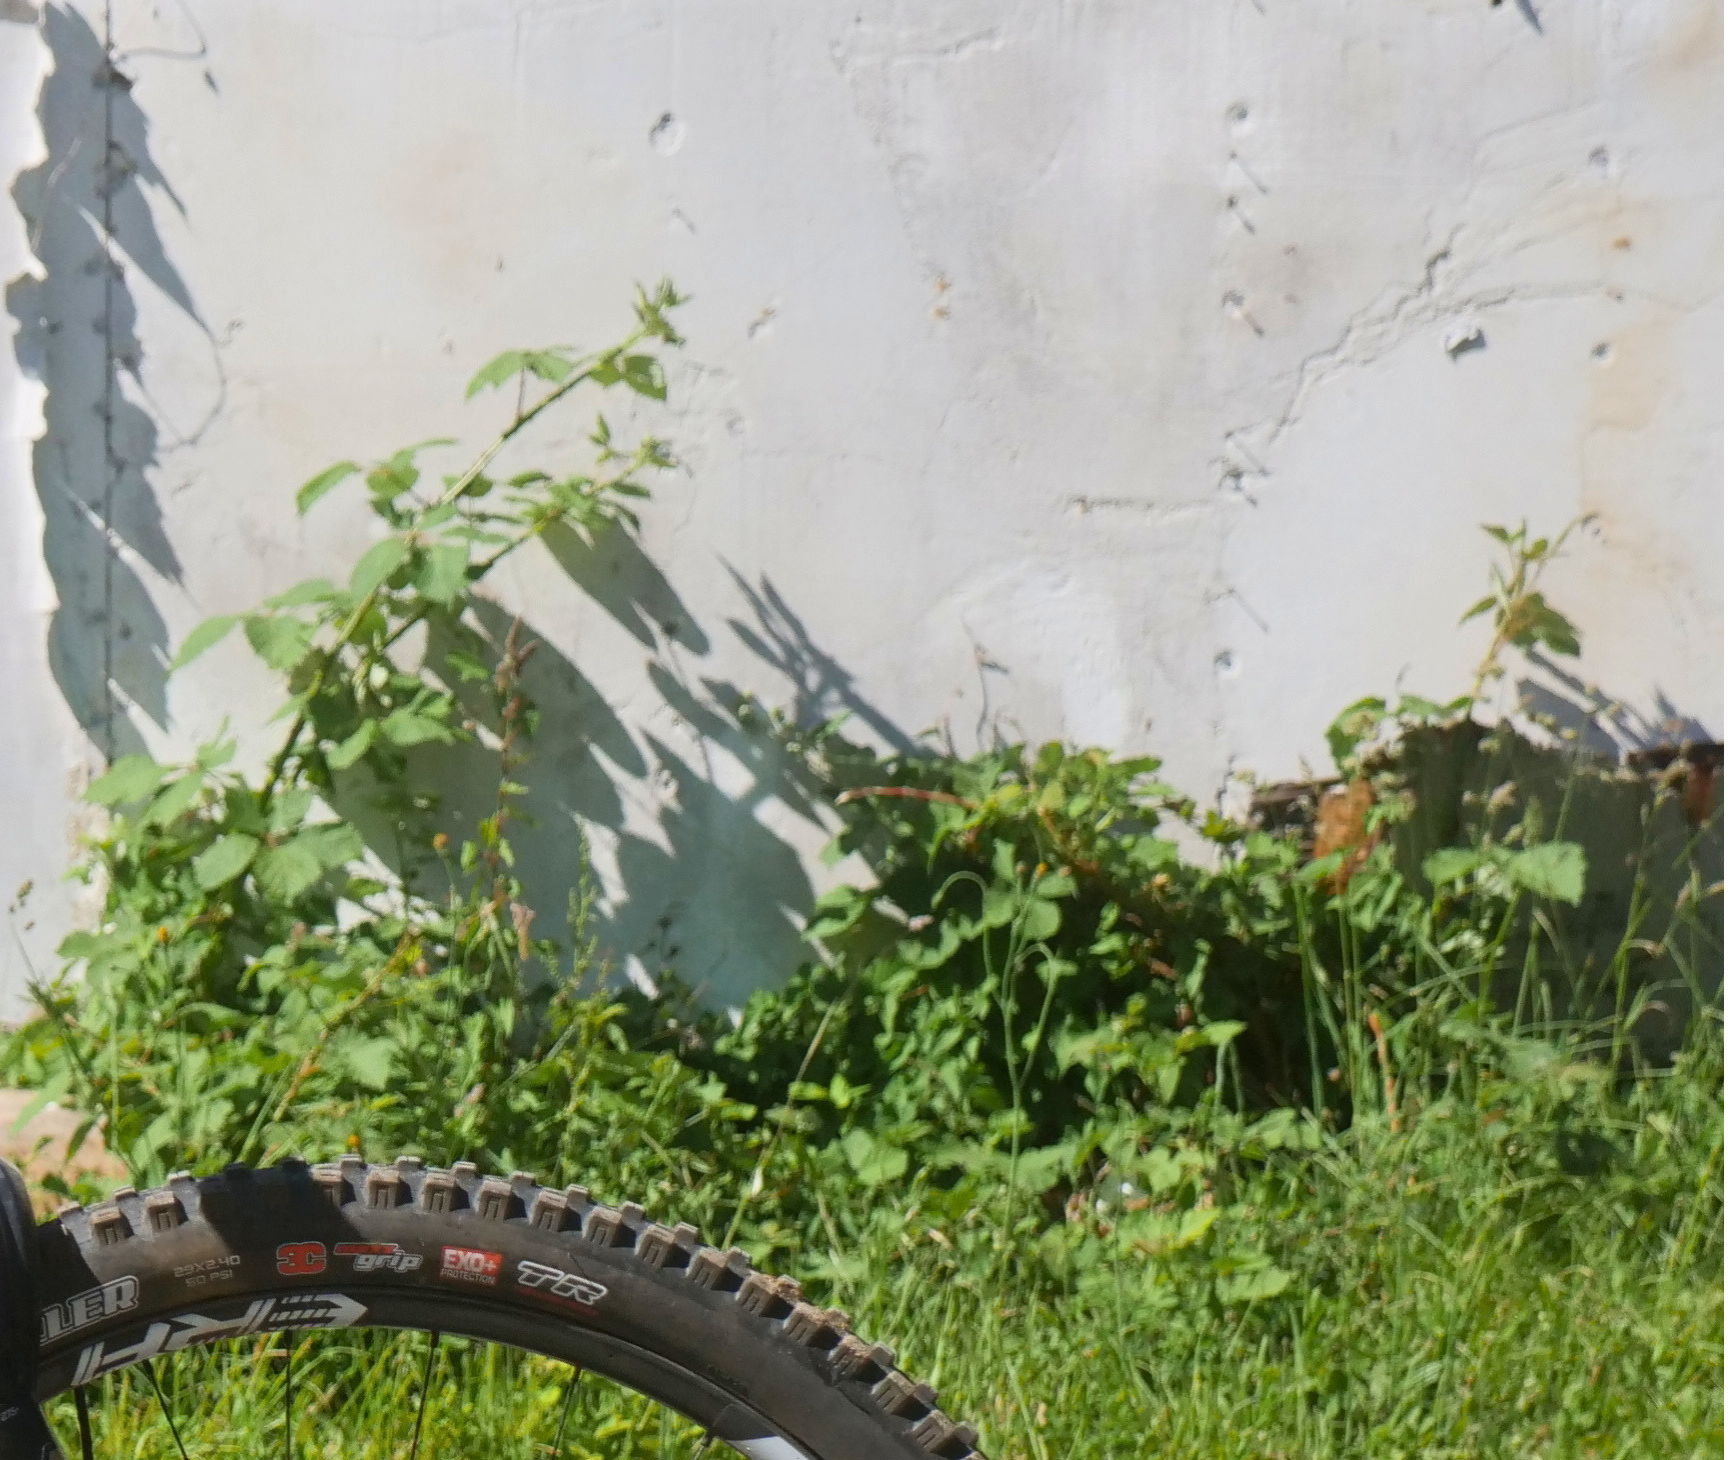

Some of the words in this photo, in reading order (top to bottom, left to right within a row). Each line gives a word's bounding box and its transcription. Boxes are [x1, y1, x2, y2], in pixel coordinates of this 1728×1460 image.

[276, 1241, 327, 1276] 3C
[352, 1250, 424, 1273] grip
[443, 1248, 497, 1272] EXO+
[440, 1267, 496, 1286] PROTECTION
[517, 1260, 609, 1306] TR
